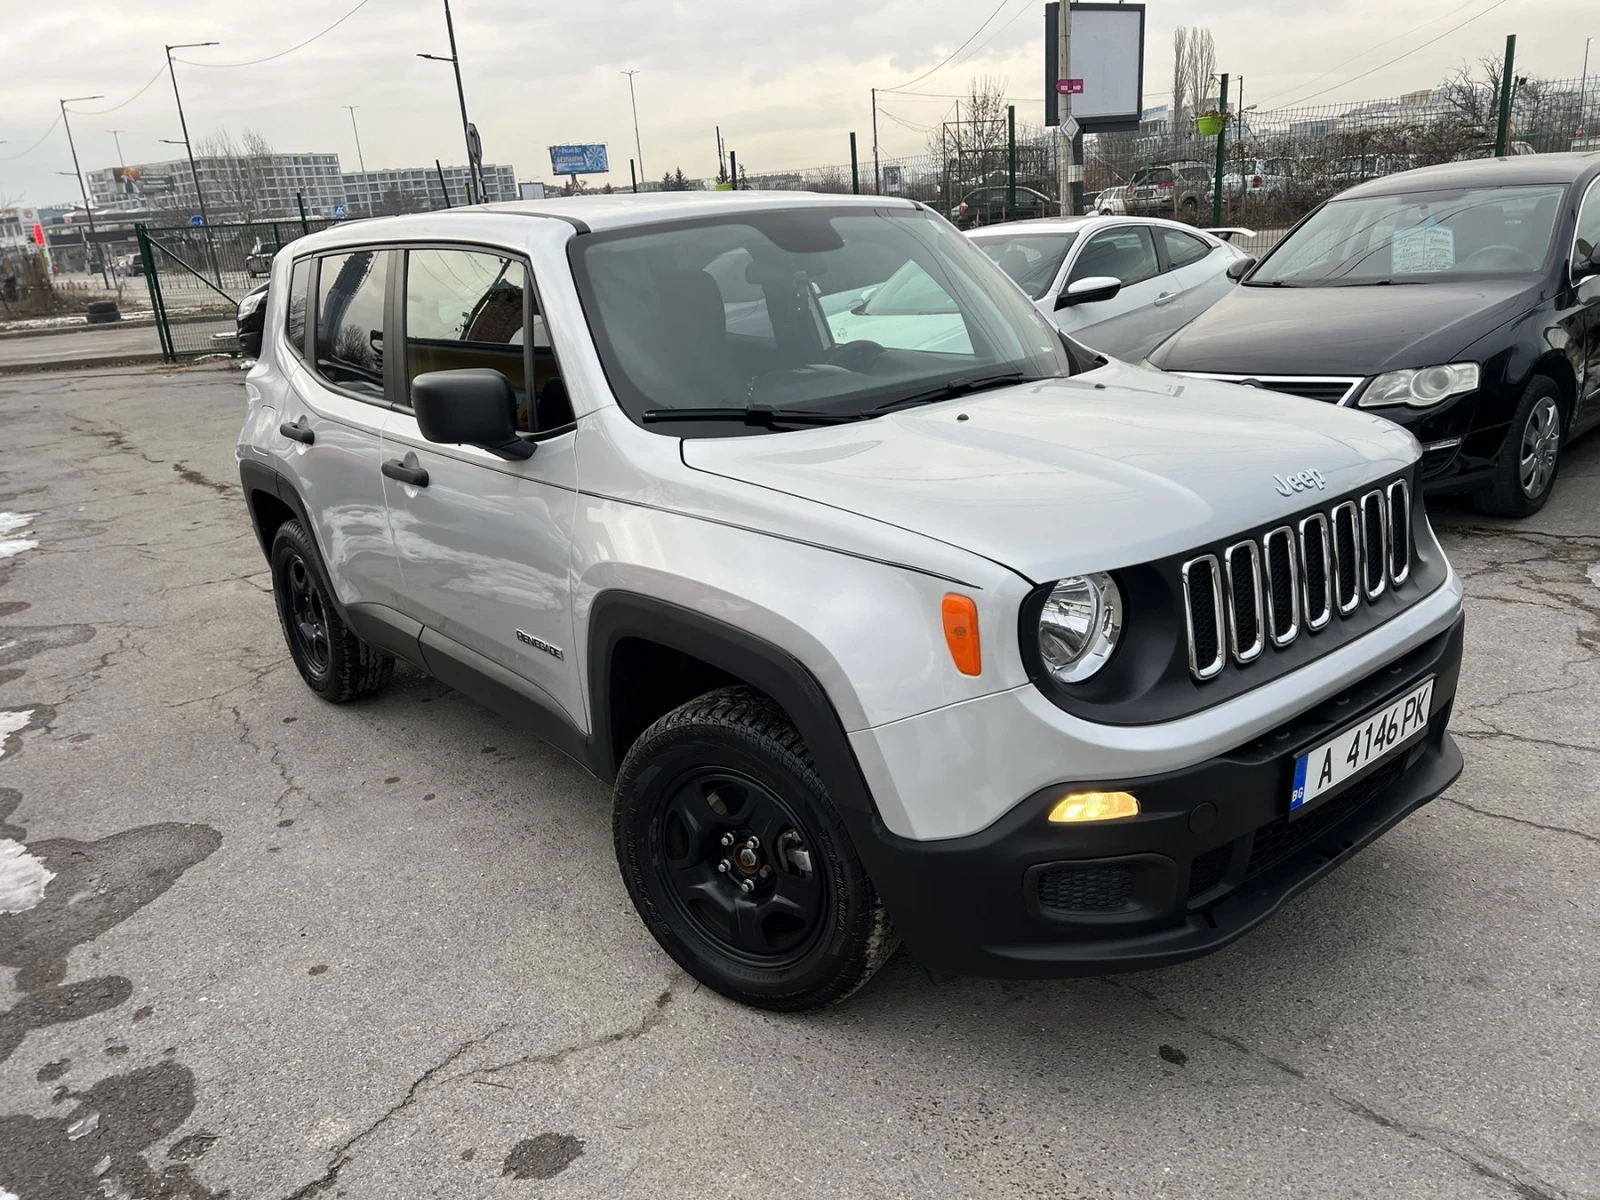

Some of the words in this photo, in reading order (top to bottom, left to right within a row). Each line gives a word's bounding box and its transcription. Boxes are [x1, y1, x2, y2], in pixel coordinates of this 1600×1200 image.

[1272, 467, 1326, 497] Jeep
[516, 628, 564, 661] RENEGADE
[1317, 747, 1332, 789] A
[1346, 707, 1399, 769] 4146
[1400, 686, 1429, 737] PK
[1292, 786, 1304, 802] BG
